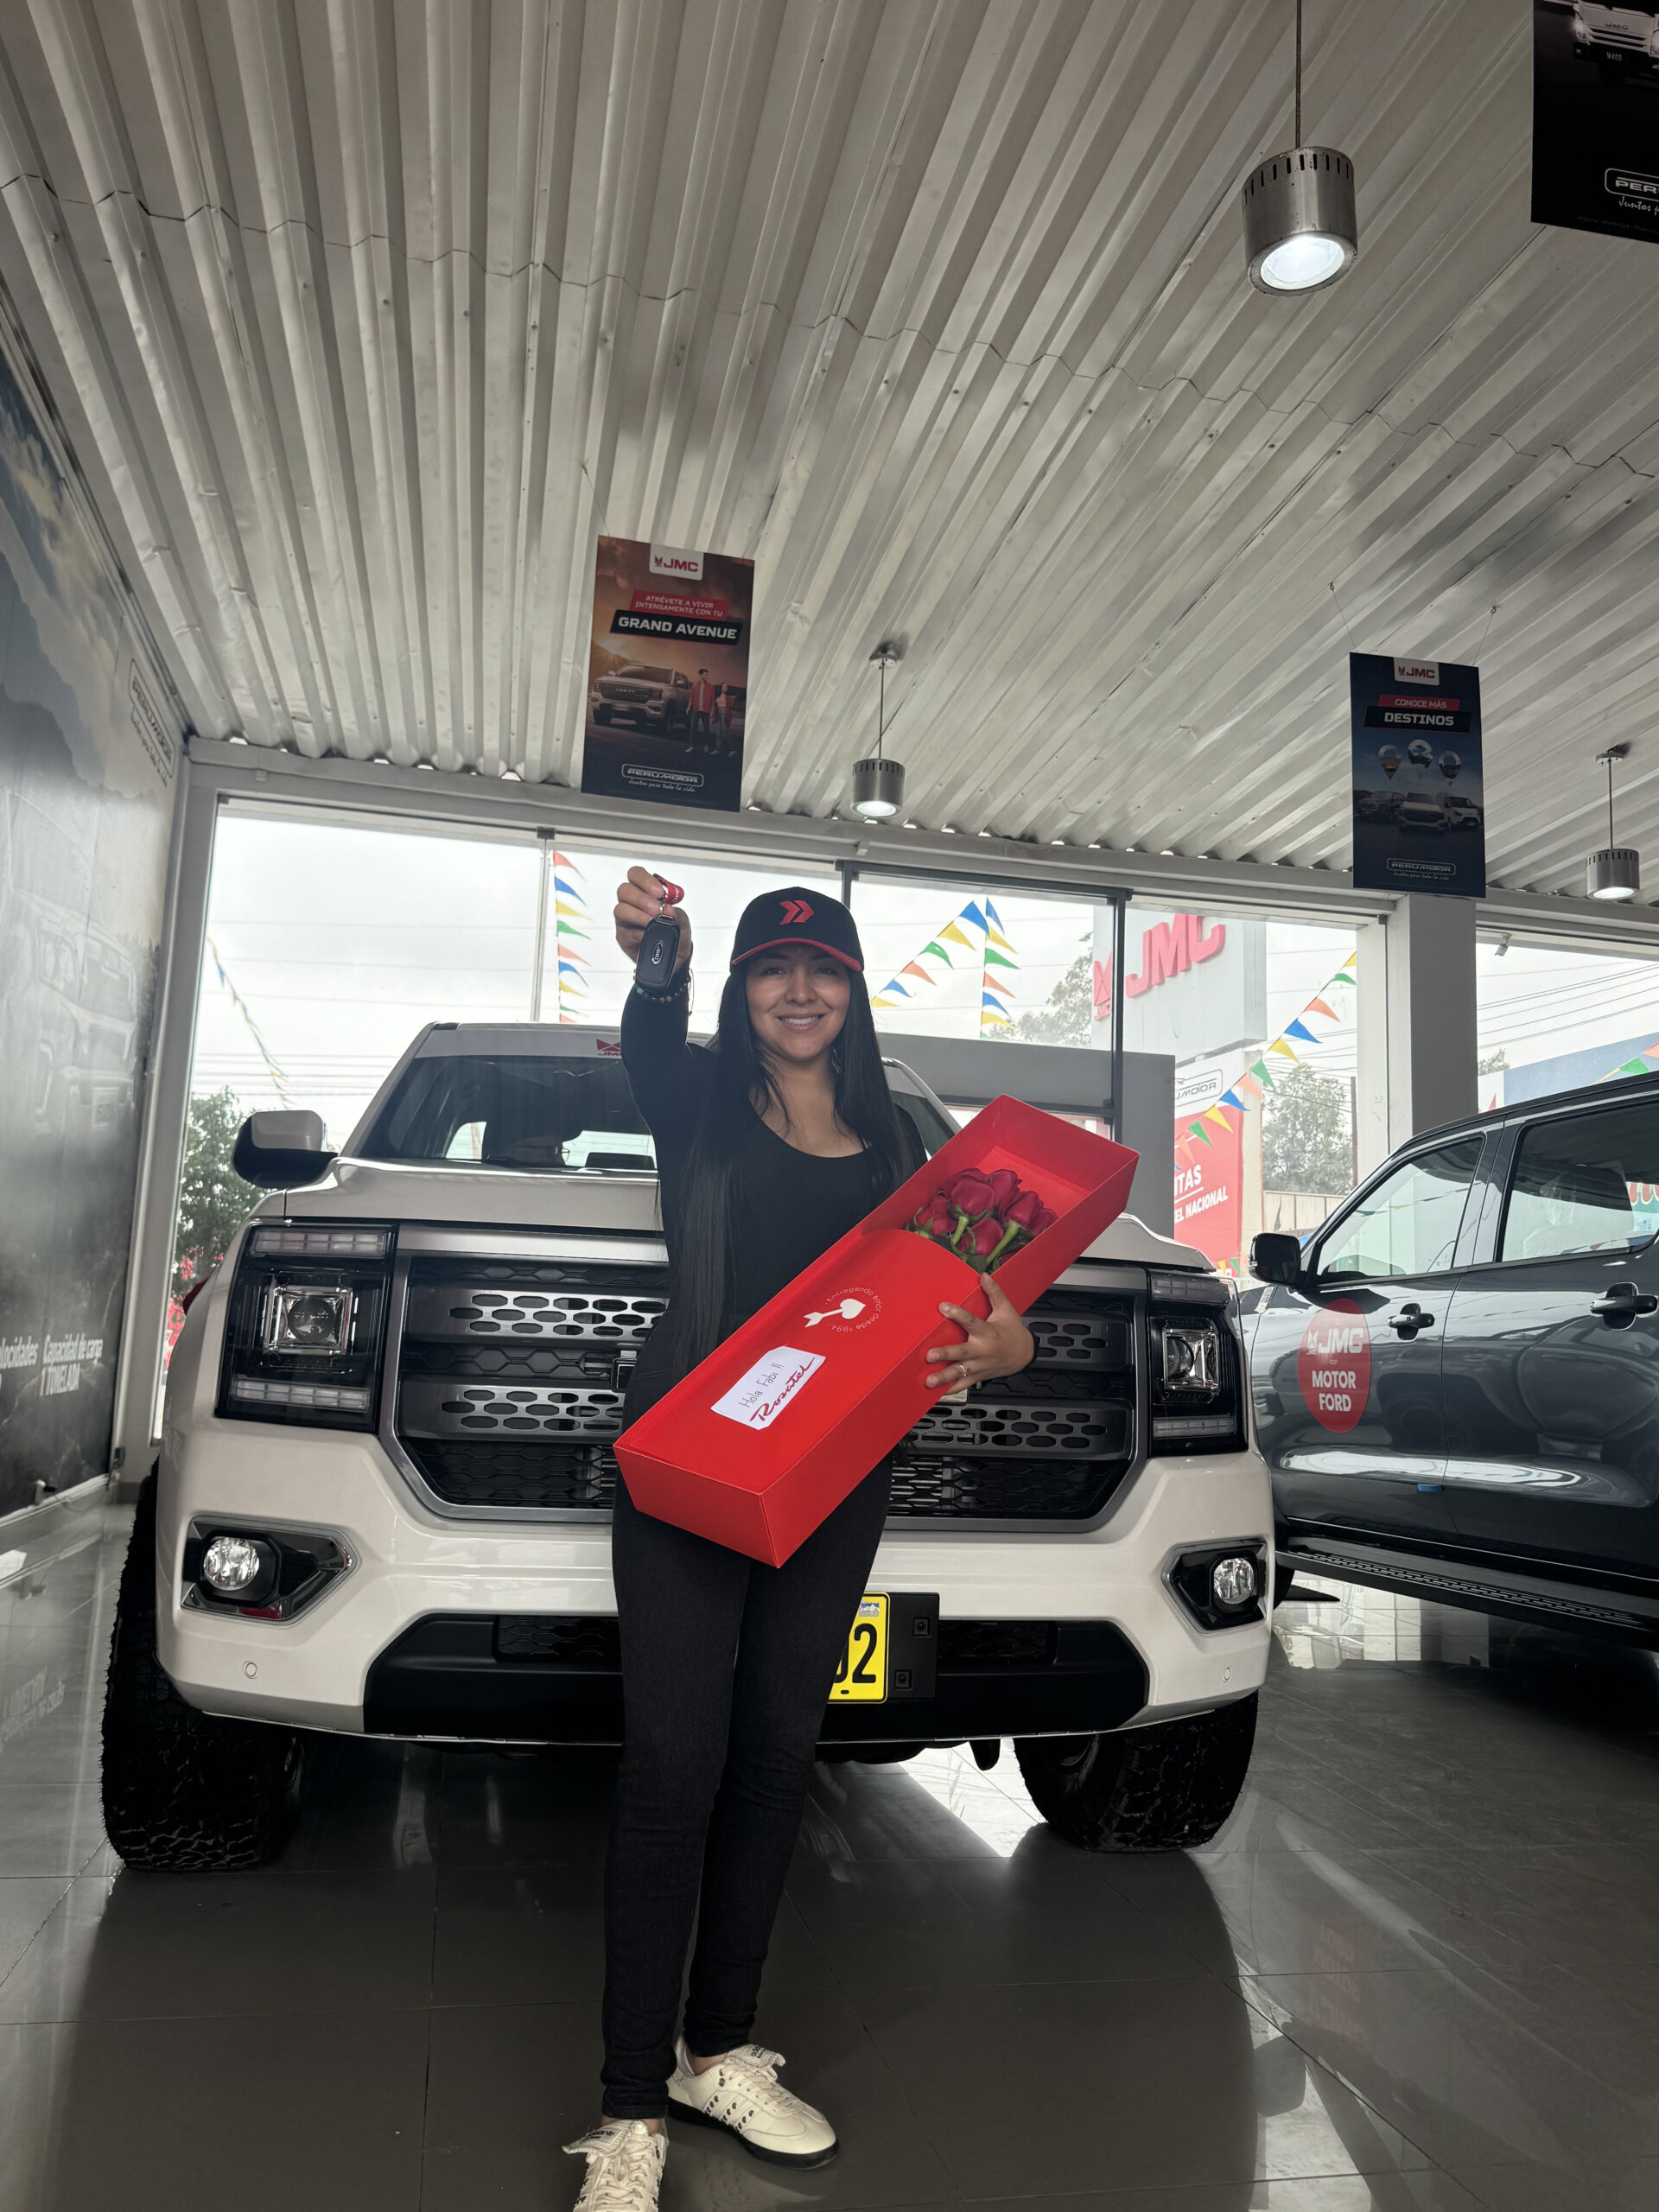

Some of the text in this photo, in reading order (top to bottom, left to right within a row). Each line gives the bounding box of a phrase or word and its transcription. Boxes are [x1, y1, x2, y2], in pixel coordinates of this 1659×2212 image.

[1615, 176, 1659, 194] PER
[664, 557, 699, 573] JMC
[635, 601, 695, 616] INTENSAMENTE
[696, 607, 711, 616] CON
[645, 594, 715, 610] ATRÉVETE A VIVIR
[618, 616, 738, 639] GRAND AVENUE
[1406, 667, 1436, 679] JMC
[1395, 698, 1447, 709] CONOCE MÁS
[1384, 711, 1454, 727] DESTINOS
[627, 767, 698, 784] PERUMOTOR
[1391, 861, 1452, 872] PERUMOTOR
[1126, 912, 1225, 998] JMC
[1185, 1185, 1229, 1218] NACIONAL
[855, 1313, 879, 1330] desde
[43, 1333, 79, 1366] Capacidad
[78, 1332, 86, 1360] de
[86, 1338, 104, 1367] carga
[1319, 1327, 1364, 1354] JMC
[1312, 1370, 1357, 1389] MOTOR
[749, 1357, 816, 1421] Rosatel
[738, 1389, 763, 1408] Hola
[1319, 1393, 1352, 1412] FORD
